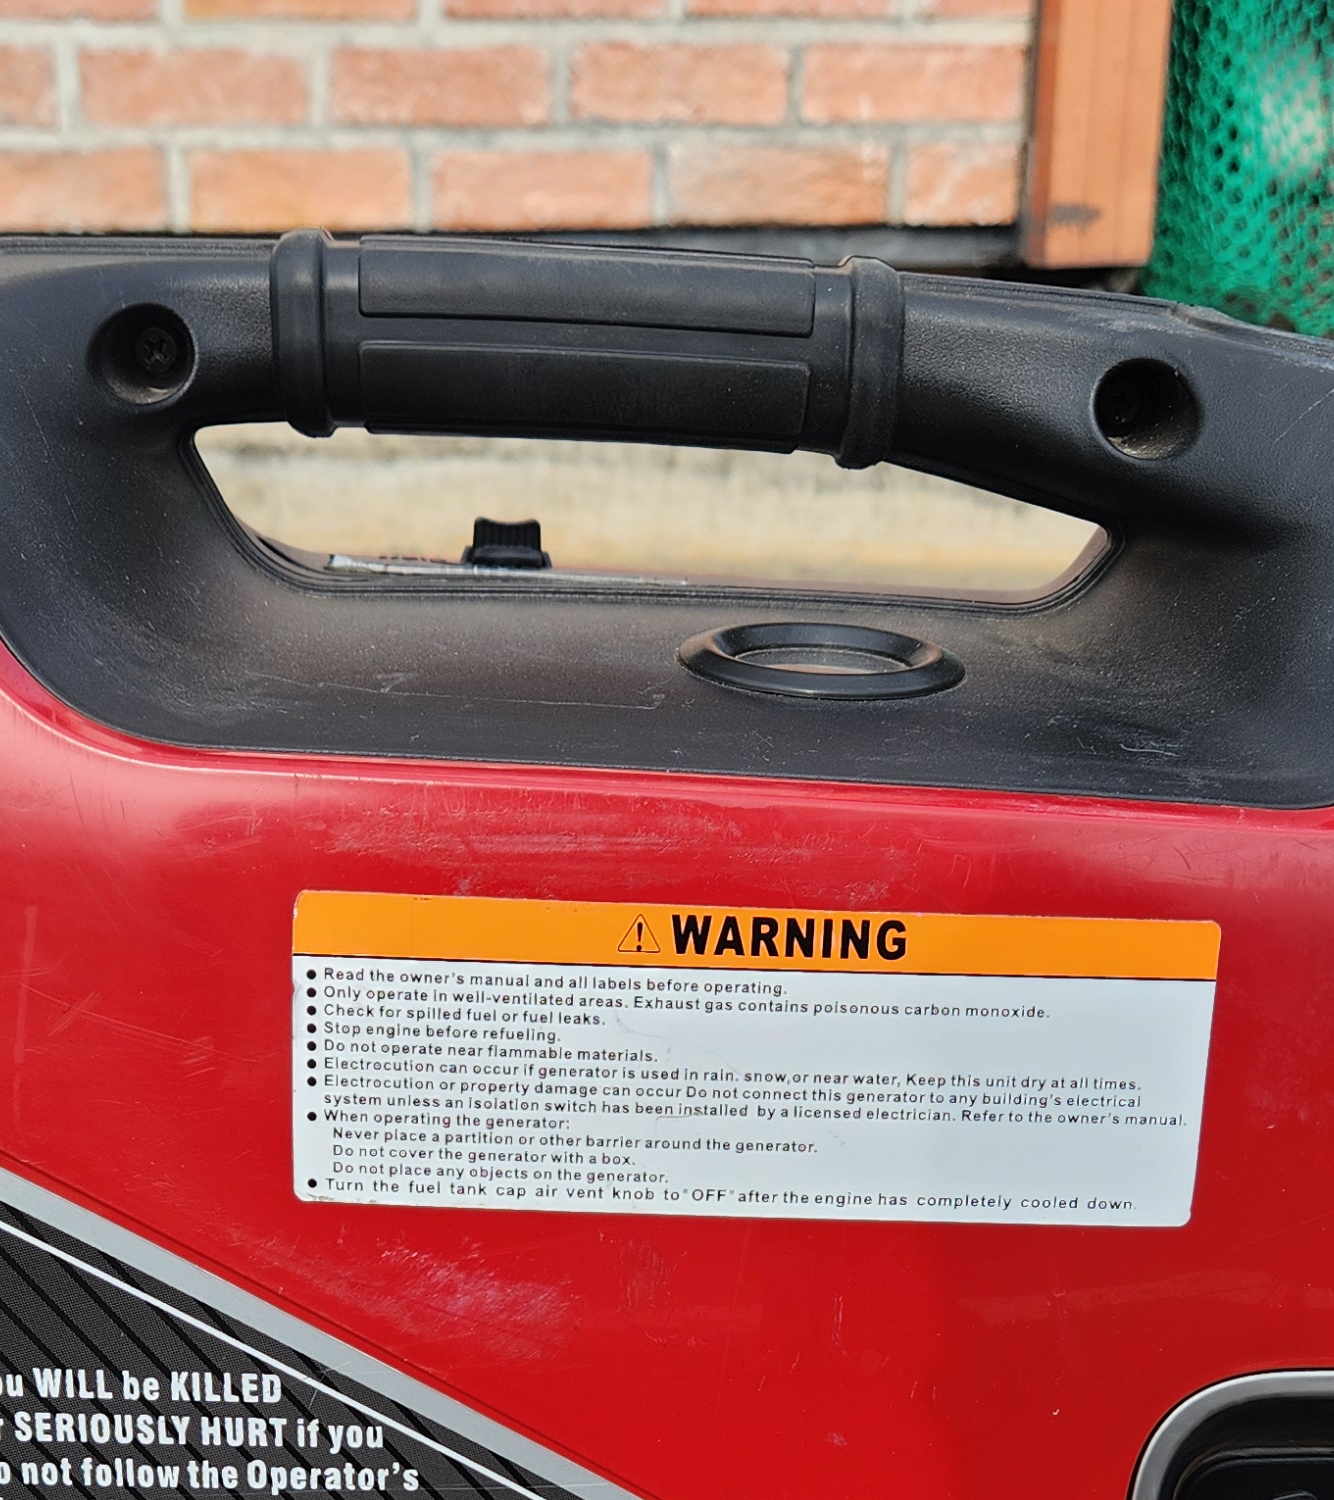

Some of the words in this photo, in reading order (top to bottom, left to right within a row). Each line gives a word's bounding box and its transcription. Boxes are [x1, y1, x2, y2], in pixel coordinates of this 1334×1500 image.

[671, 914, 907, 961] WARNING
[323, 966, 365, 982] Read
[368, 968, 395, 983] the
[399, 972, 465, 985] owner's
[469, 973, 530, 987] manual
[533, 975, 564, 989] and
[568, 975, 588, 989] all
[592, 975, 642, 991] labels
[646, 977, 699, 993] before
[703, 980, 787, 998] operating.
[323, 985, 361, 1002] Only
[365, 988, 429, 1003] operate
[432, 988, 448, 1002] in
[451, 989, 574, 1007] well-ventilated
[578, 997, 629, 1008] areas.
[632, 995, 700, 1010] Exhaust
[704, 1000, 733, 1014] gas
[737, 999, 809, 1013] contains
[812, 1000, 899, 1016] poisonous
[903, 1003, 961, 1017] carbon
[965, 1004, 1050, 1019] monoxide.
[323, 1002, 375, 1018] Check
[378, 1005, 402, 1018] for
[405, 1006, 462, 1022] spilled
[465, 1007, 497, 1022] fuel
[501, 1012, 519, 1023] or
[521, 1009, 554, 1024] fuel
[557, 1010, 606, 1026] leaks.
[323, 1020, 361, 1038] Stop
[365, 1022, 421, 1039] engine
[425, 1024, 479, 1039] before
[482, 1026, 561, 1045] refueling.
[323, 1038, 345, 1052] Do
[349, 1040, 377, 1053] not
[380, 1042, 443, 1057] operate
[447, 1045, 484, 1057] near
[486, 1043, 573, 1060] flammable
[576, 1048, 658, 1063] materials.
[323, 1092, 382, 1108] system
[386, 1094, 441, 1108] unless
[444, 1098, 464, 1109] an
[468, 1096, 539, 1112] isolation
[543, 1099, 597, 1113] switch
[601, 1100, 630, 1114] has
[635, 1102, 674, 1116] been
[677, 1102, 748, 1117] installed
[756, 1104, 776, 1121] by
[779, 1108, 789, 1118] a
[793, 1105, 862, 1120] licensed
[865, 1106, 956, 1122] electrician.
[960, 1108, 1005, 1123] Refer
[1007, 1109, 1024, 1123] to
[1027, 1109, 1052, 1124] the
[1057, 1111, 1120, 1125] owner's
[1124, 1113, 1187, 1126] manual.
[323, 1108, 368, 1123] When
[372, 1111, 451, 1129] operating
[456, 1112, 481, 1127] the
[332, 1126, 380, 1140] Never
[384, 1128, 427, 1144] place
[431, 1132, 440, 1143] a
[444, 1130, 513, 1146] partition
[518, 1135, 536, 1146] or
[538, 1133, 582, 1147] other
[585, 1134, 641, 1149] barrier
[644, 1137, 702, 1150] around
[705, 1137, 731, 1151] the
[734, 1140, 818, 1154] generator.
[332, 1161, 354, 1174] Do
[358, 1162, 385, 1175] not
[388, 1162, 432, 1178] place
[435, 1167, 465, 1181] any
[468, 1165, 528, 1182] objects
[533, 1169, 553, 1180] on
[556, 1167, 582, 1181] the
[586, 1171, 668, 1189] generator.
[32, 1367, 113, 1400] WILL
[121, 1370, 160, 1401] be
[170, 1371, 281, 1403] KILLED
[13, 1410, 190, 1445] SERIOUSLY
[200, 1416, 287, 1447] HURT
[296, 1418, 319, 1448] if
[327, 1424, 383, 1455] you
[20, 1457, 73, 1486] not
[80, 1456, 180, 1488] follow
[186, 1459, 238, 1489] the
[246, 1459, 419, 1496] Operator's
